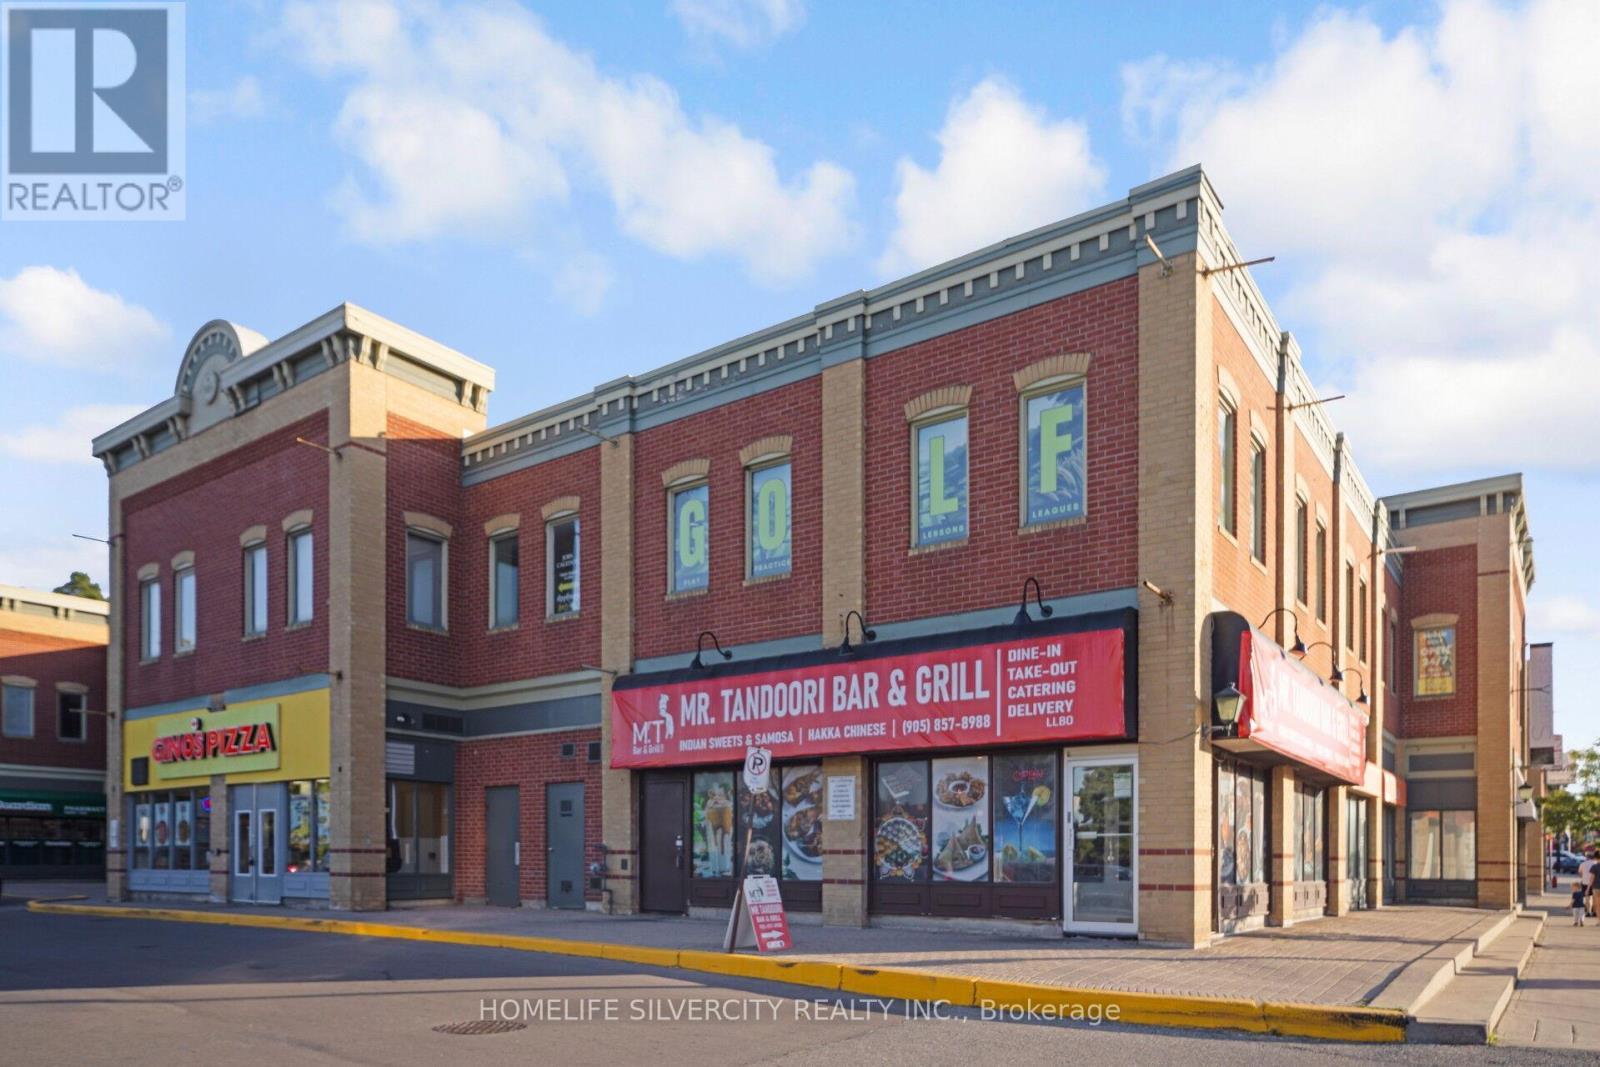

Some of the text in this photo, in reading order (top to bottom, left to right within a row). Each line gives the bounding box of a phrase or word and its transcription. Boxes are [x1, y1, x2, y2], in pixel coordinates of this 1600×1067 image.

[1040, 404, 1073, 494] F
[929, 435, 959, 516] L
[758, 479, 787, 551] O
[1032, 503, 1080, 518] LEAGUES
[679, 499, 705, 567] G
[922, 525, 965, 539] LESSONS
[1007, 644, 1062, 662] DINE-IN
[1007, 660, 1078, 680] TAKE-OUT
[680, 660, 990, 727] MR. TANDOORI BAR & GRILL
[1007, 680, 1077, 699] CATERING
[1007, 699, 1074, 717] DELIVERY
[808, 722, 886, 741] HAKKA CHINESE
[902, 714, 991, 736] (905) 857-8988
[207, 721, 274, 757] PIZZA
[679, 730, 794, 752] INDIAN SWEETS & SAMOSA
